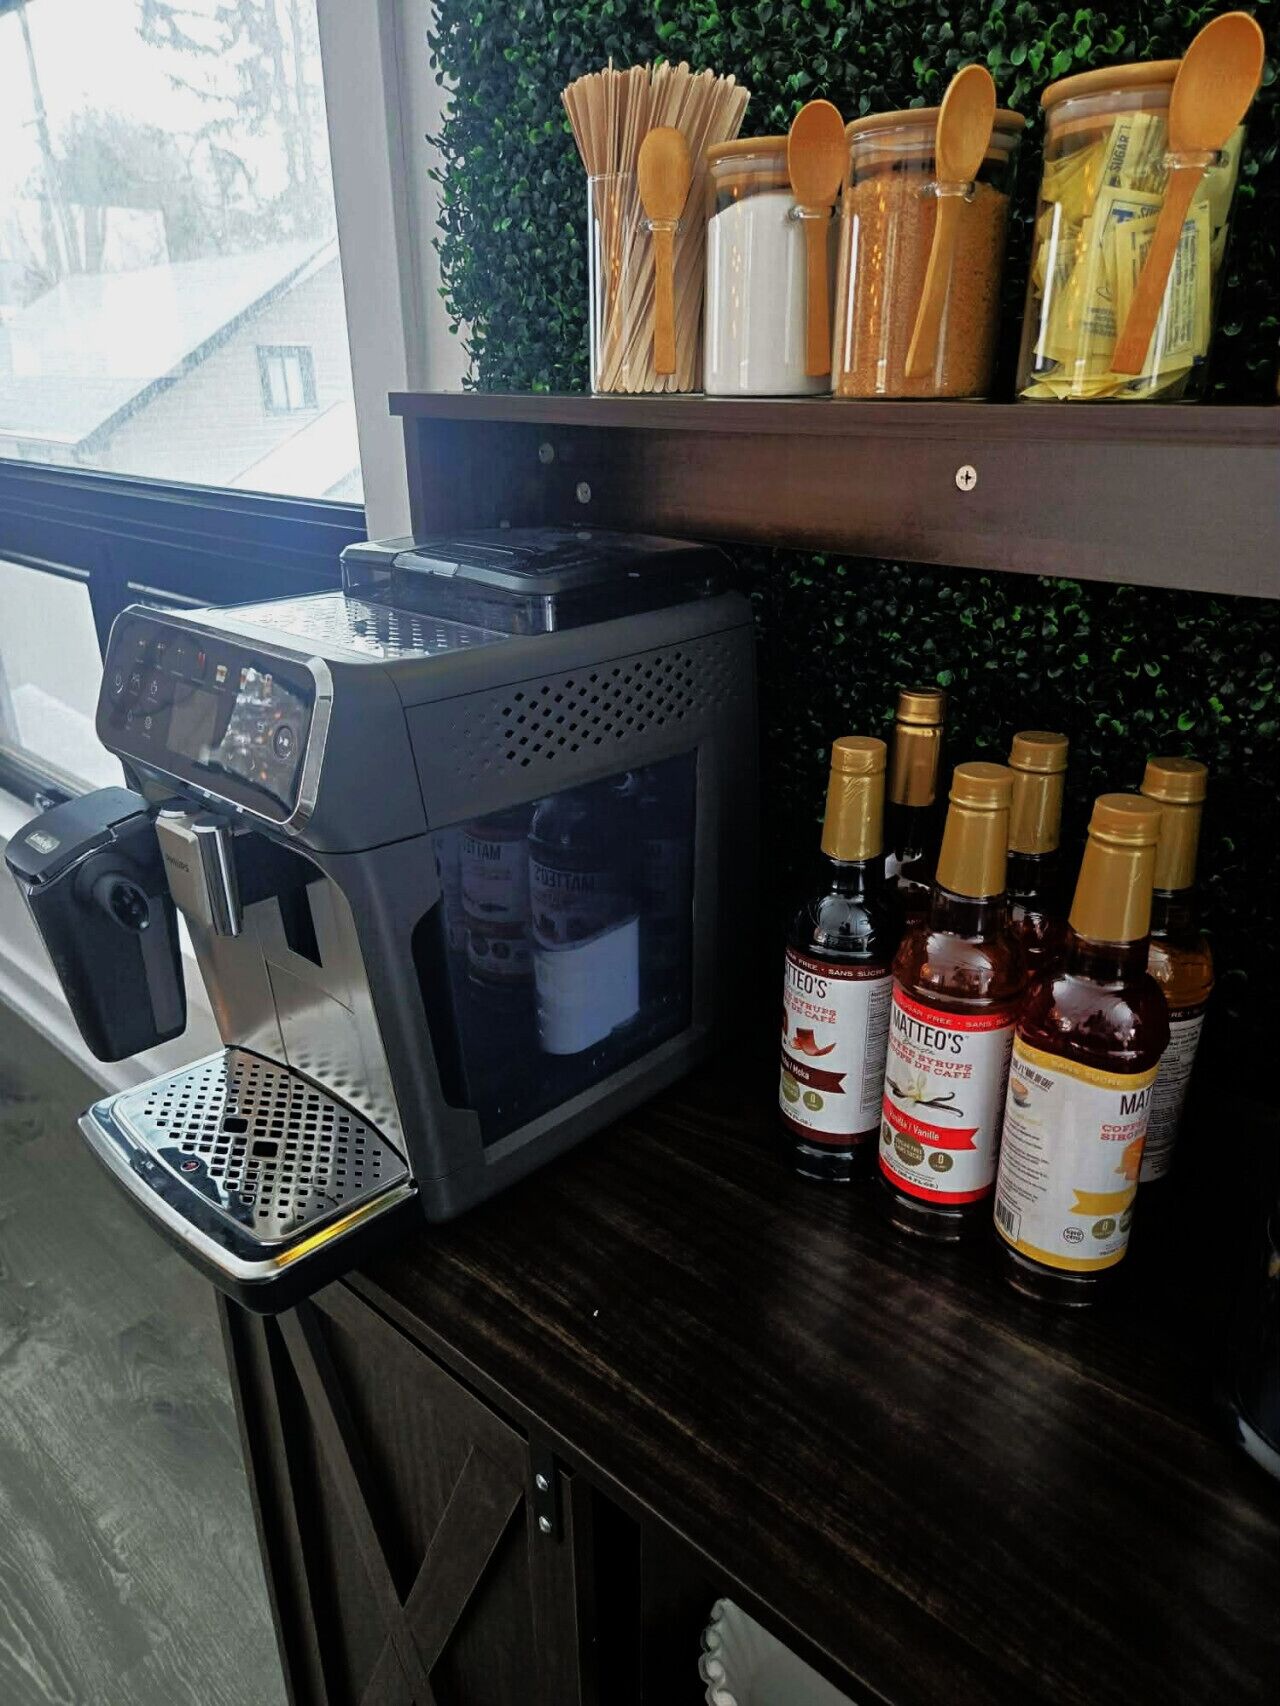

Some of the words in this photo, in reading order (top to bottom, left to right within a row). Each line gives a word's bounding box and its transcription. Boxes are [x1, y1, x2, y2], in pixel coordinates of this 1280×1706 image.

[1109, 134, 1129, 172] SUGAR
[784, 962, 827, 999] TTEO'S
[828, 969, 853, 977] SANS
[926, 1014, 953, 1025] FREE
[893, 1004, 964, 1054] MATTEO'S
[914, 1061, 931, 1072] DE
[918, 1054, 973, 1072] SYRUPS
[1120, 1084, 1153, 1116] MAT
[913, 1125, 940, 1142] Vanille
